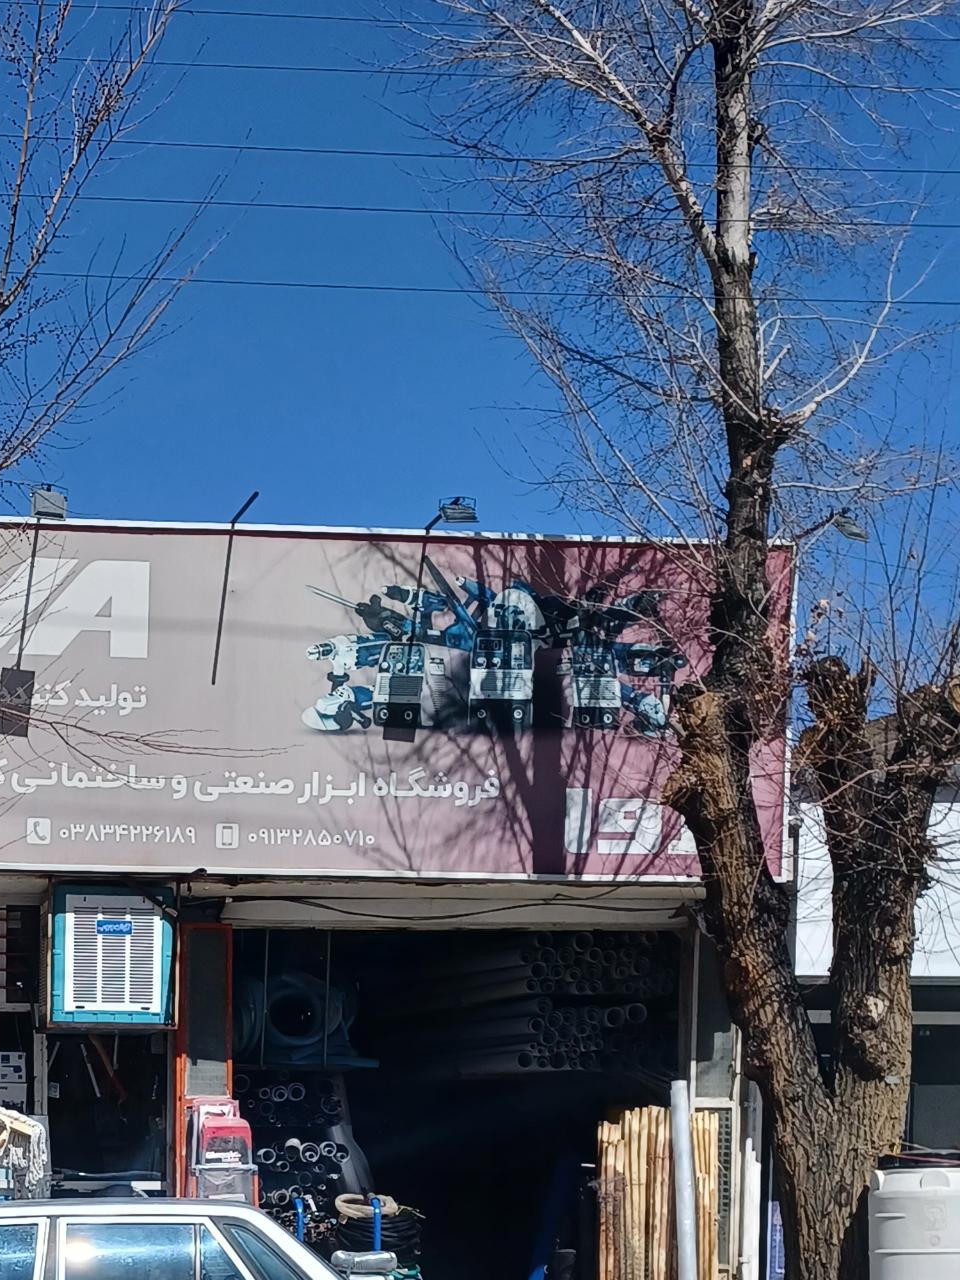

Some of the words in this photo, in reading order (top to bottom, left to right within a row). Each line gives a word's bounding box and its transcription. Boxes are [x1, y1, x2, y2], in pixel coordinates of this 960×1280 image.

[75, 683, 147, 716] تولید
[11, 762, 166, 794] ساختمانی
[171, 774, 188, 800] و
[193, 771, 295, 801] صنعتی
[297, 771, 366, 804] ابزار
[372, 767, 501, 806] فروشگاه
[59, 822, 197, 844] ۰۳۸۳۴۲۲۶۱۸۹
[248, 827, 375, 846] ۰۹۱۳۲۸۵۰۷۱۰
